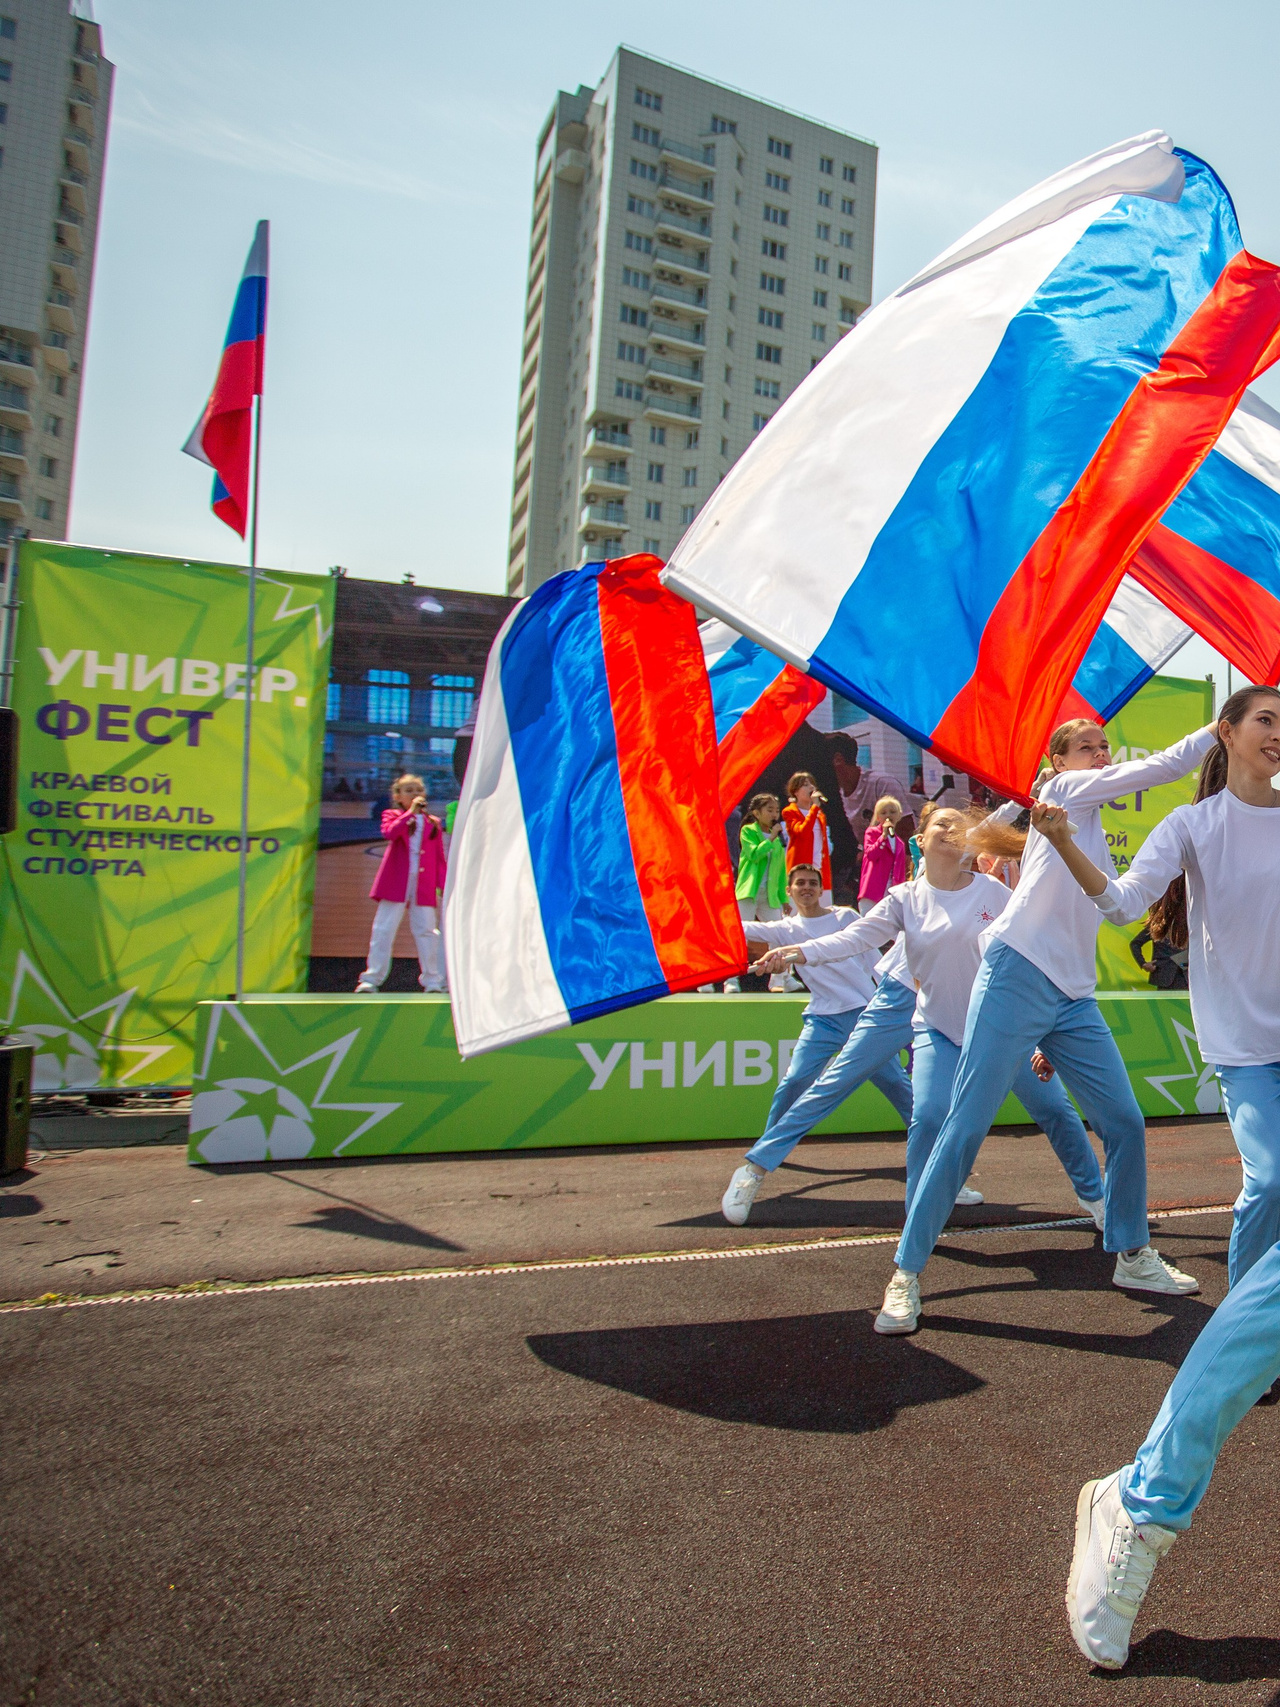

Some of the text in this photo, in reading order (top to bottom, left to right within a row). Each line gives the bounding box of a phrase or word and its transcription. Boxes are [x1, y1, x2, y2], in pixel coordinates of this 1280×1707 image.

[37, 647, 307, 707] УНИВЕР.
[35, 699, 214, 747] ФЕСТ
[30, 771, 172, 795] КРАЕВОЙ
[27, 799, 215, 825] ФЕСТИВАЛЬ
[26, 828, 280, 855] СТУДЕНЧЕСКОГО
[23, 856, 146, 877] СПОРТА
